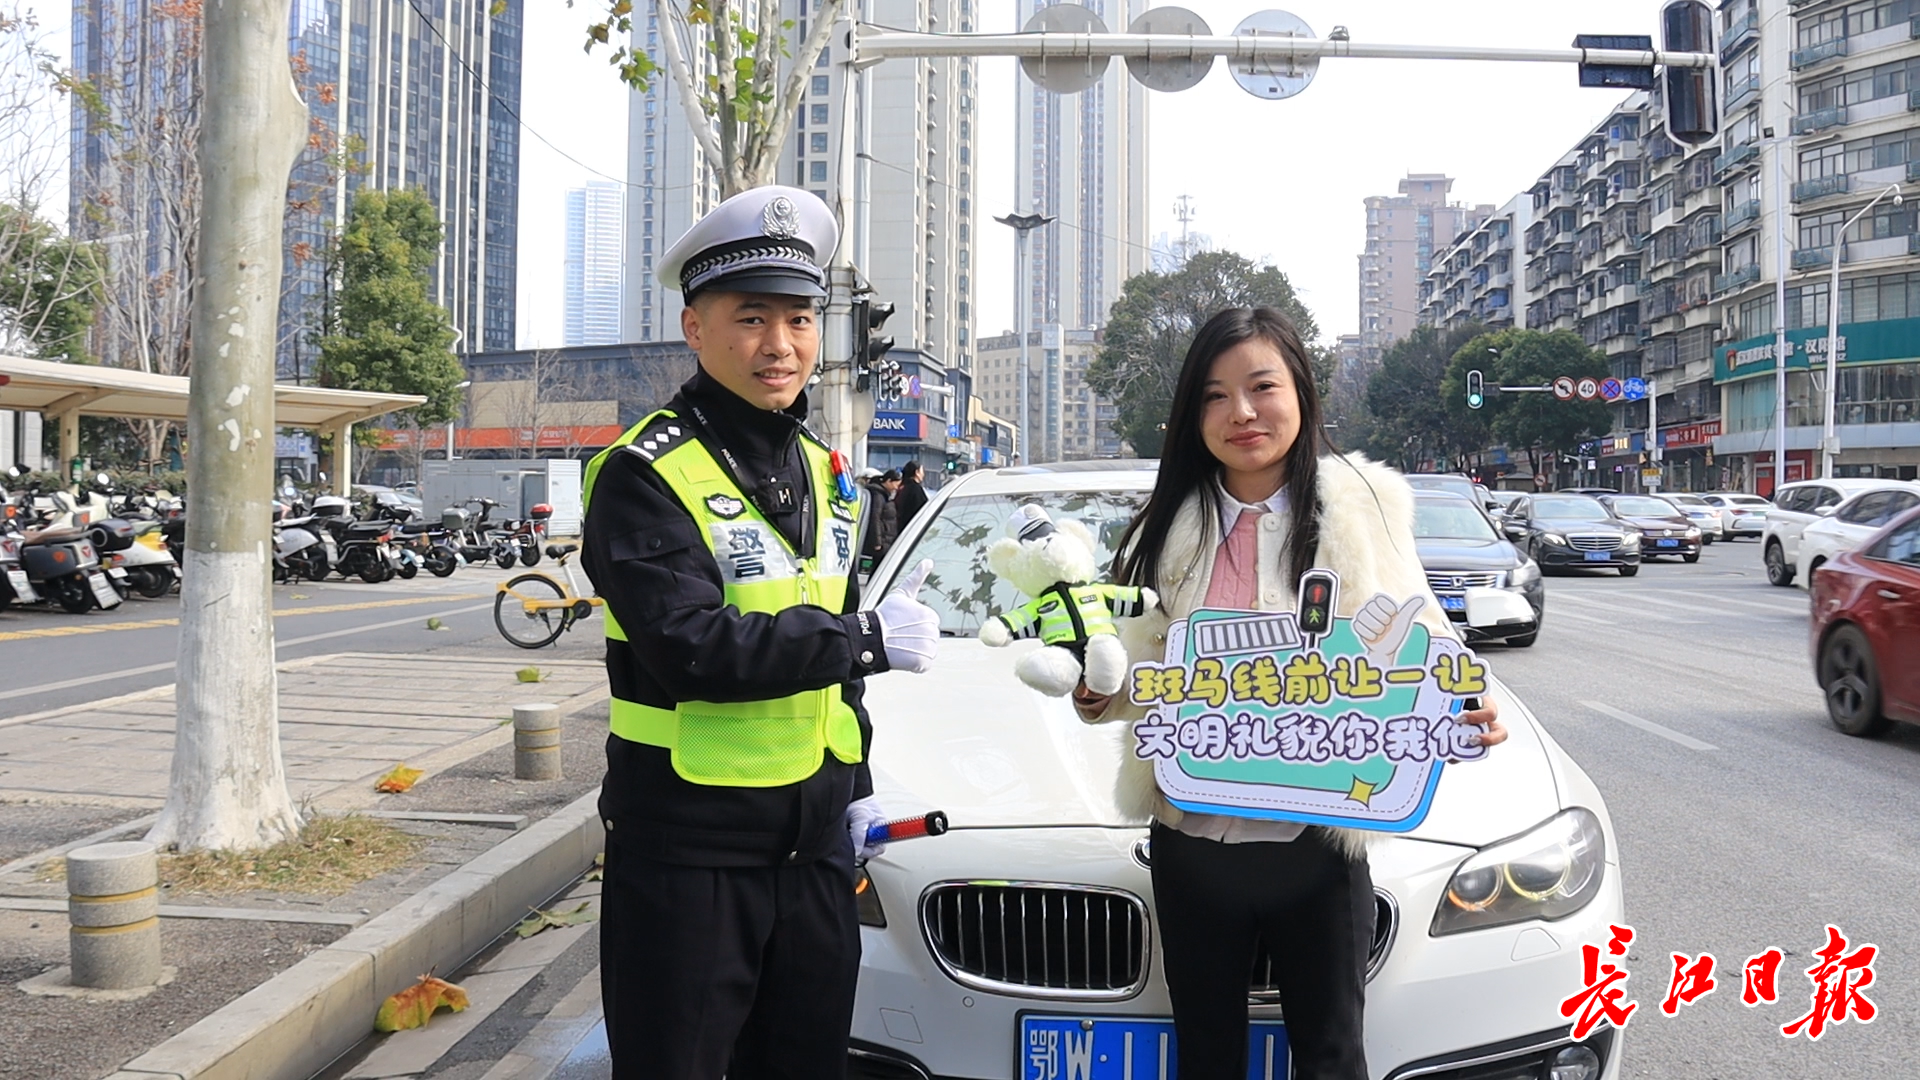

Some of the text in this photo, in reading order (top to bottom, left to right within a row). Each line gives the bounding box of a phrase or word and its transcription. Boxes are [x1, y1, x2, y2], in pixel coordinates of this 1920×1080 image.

[1581, 383, 1594, 395] 40
[873, 418, 906, 431] BANK
[720, 448, 739, 470] POLICE
[728, 527, 766, 578] 警
[1133, 655, 1487, 707] 斑马线前让一让
[1134, 711, 1486, 762] 文明礼貌你我他
